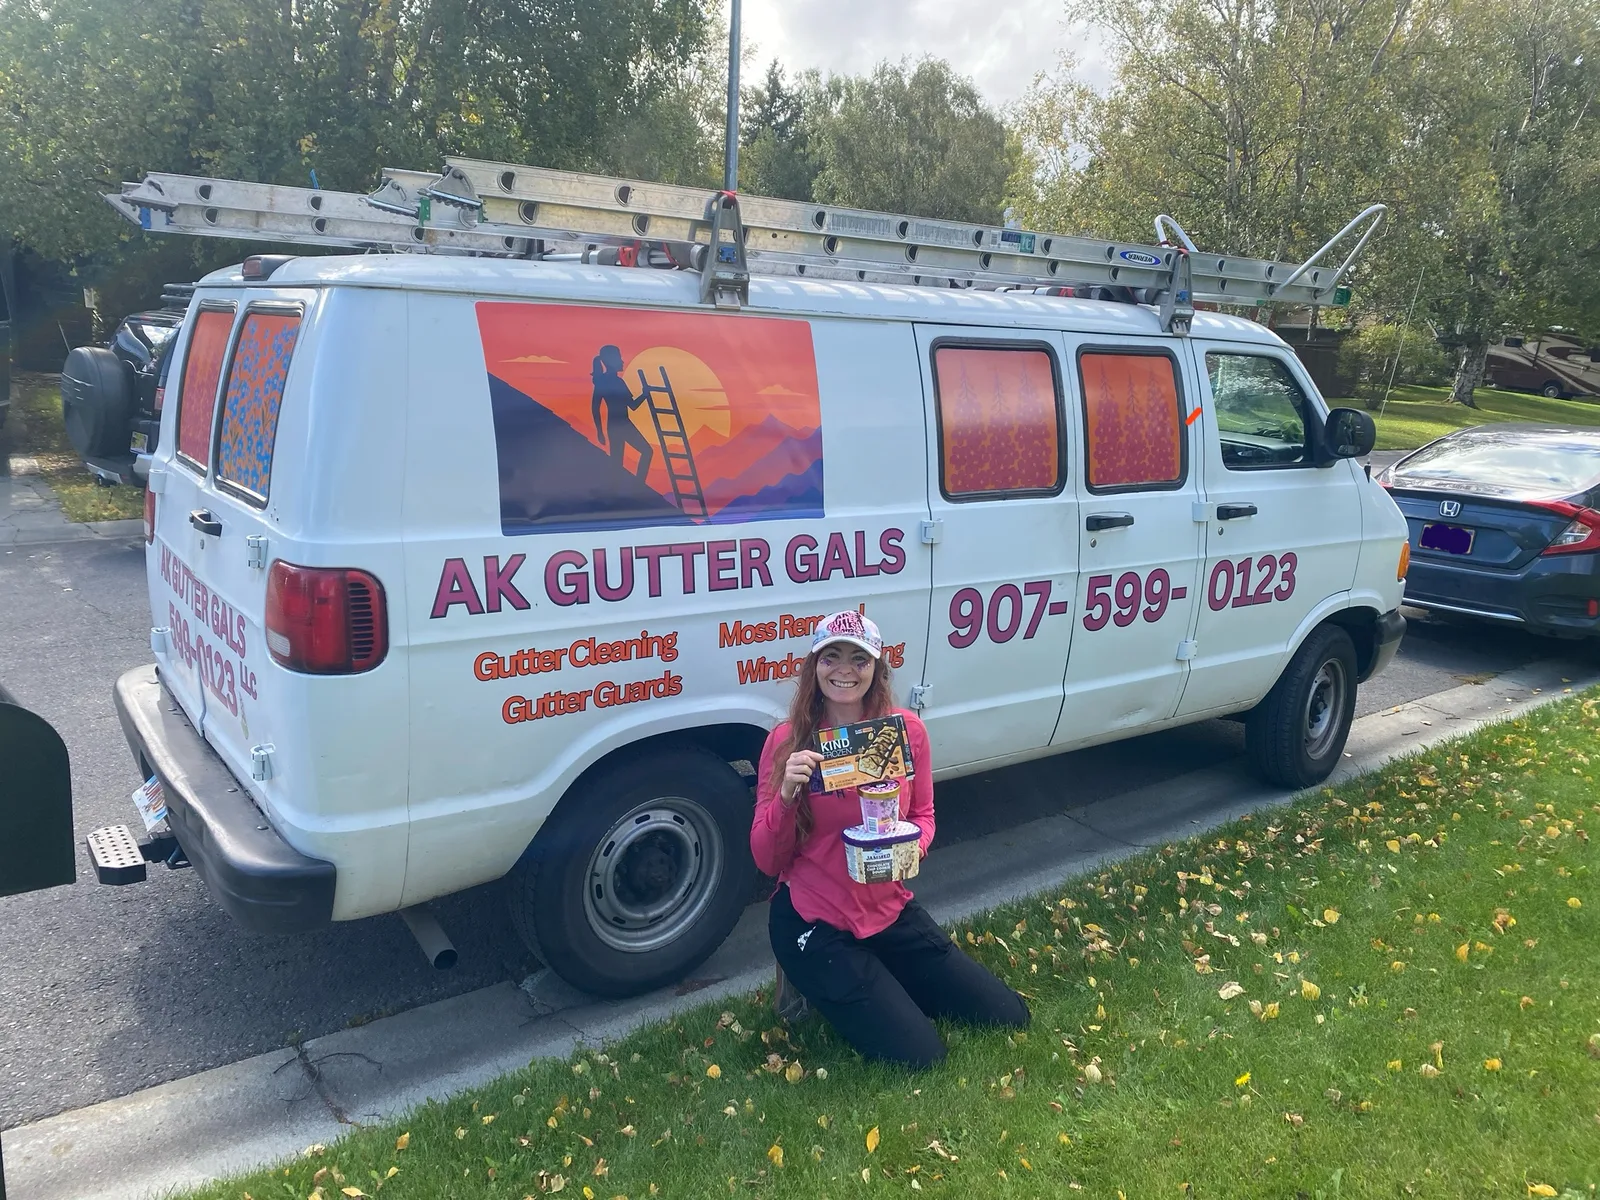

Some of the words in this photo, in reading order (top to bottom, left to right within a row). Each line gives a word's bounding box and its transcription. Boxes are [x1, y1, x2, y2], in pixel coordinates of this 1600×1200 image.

[1127, 253, 1153, 263] WERNER
[430, 553, 531, 619] AK
[544, 537, 773, 605] GUTTER
[784, 527, 906, 584] GALS
[161, 544, 172, 587] AK
[172, 556, 209, 628] GUTTER
[211, 594, 246, 660] GALS
[947, 580, 1068, 649] 907-
[1083, 568, 1187, 632] 599-
[1207, 552, 1298, 612] 0123
[474, 647, 568, 682] Gutter
[568, 630, 679, 667] Cleaning
[719, 620, 778, 648] Moss
[169, 600, 238, 717] 599-0123
[239, 661, 258, 701] LLC
[737, 652, 805, 685] Windo
[502, 689, 593, 724] Gutter
[593, 670, 683, 708] Guards
[820, 738, 850, 752] KIND
[822, 747, 852, 758] FROZEN
